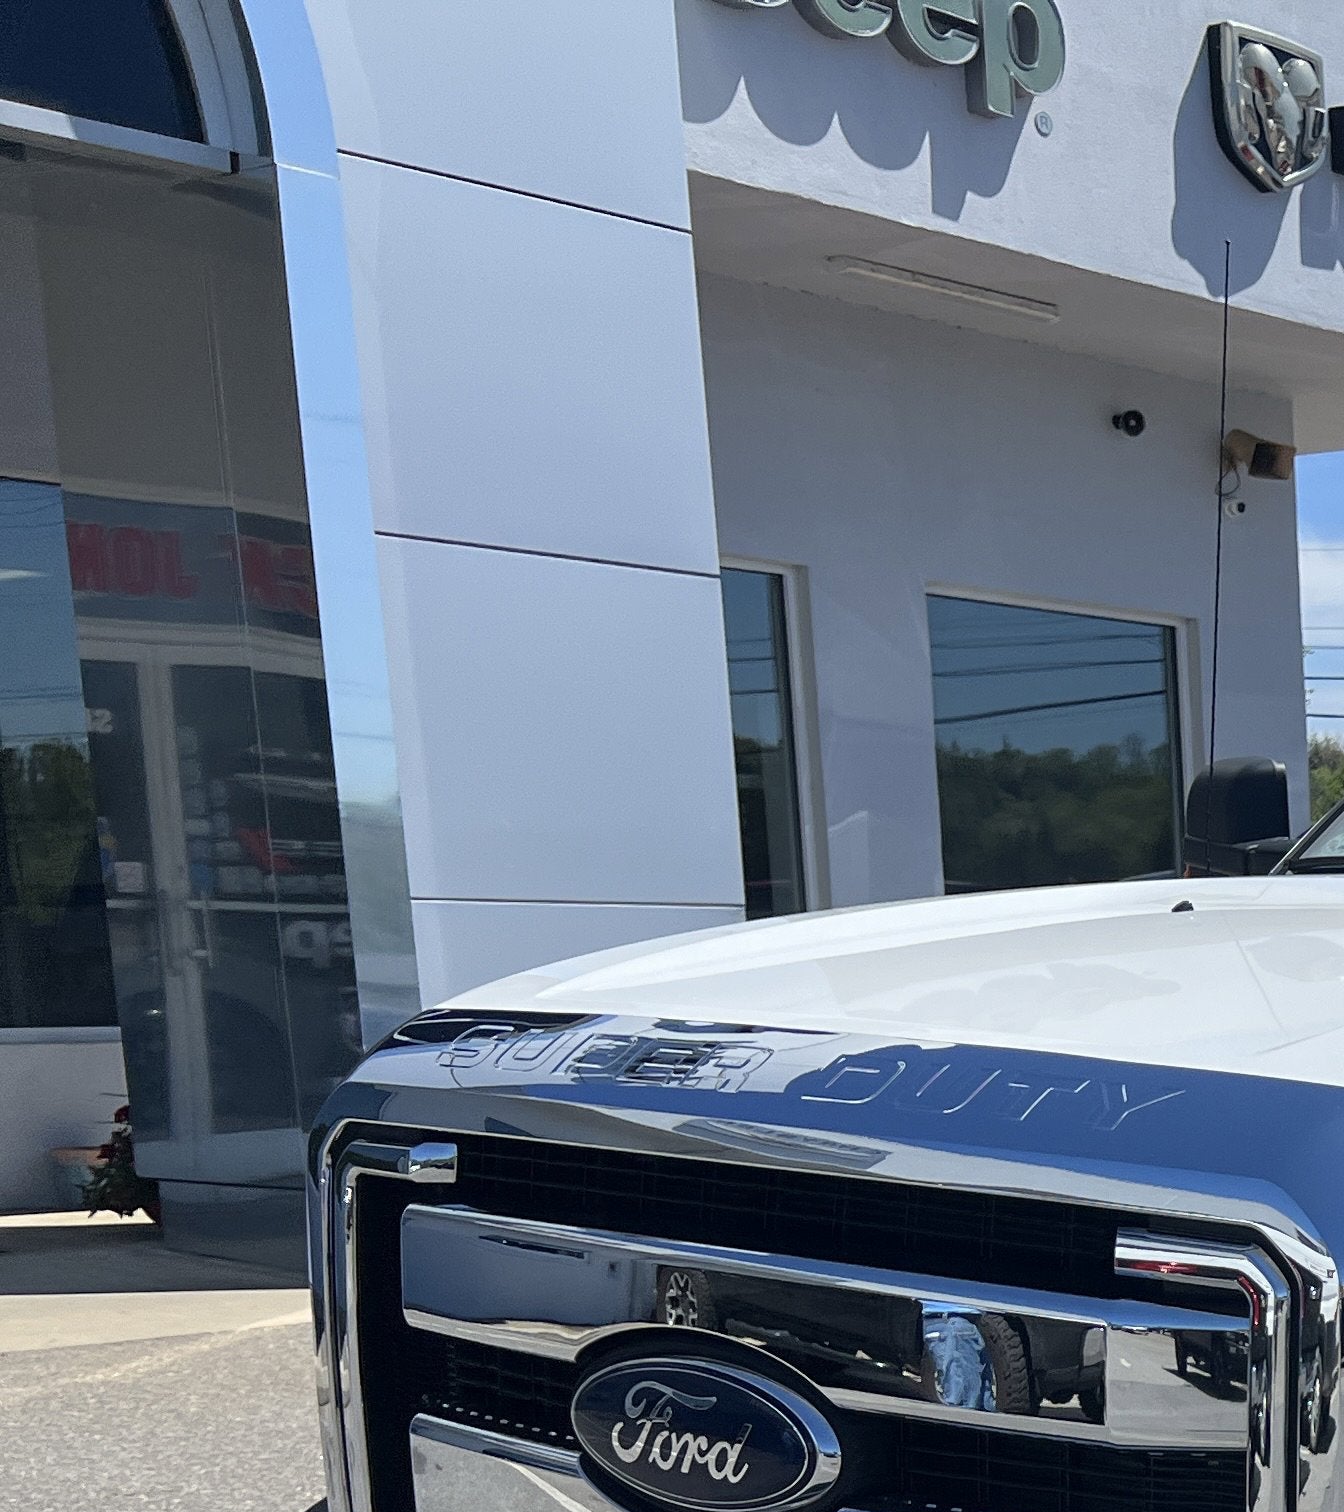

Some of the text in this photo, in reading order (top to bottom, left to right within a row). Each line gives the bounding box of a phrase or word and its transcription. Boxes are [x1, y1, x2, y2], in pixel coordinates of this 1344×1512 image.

[736, 0, 1066, 118] ep
[435, 1024, 1188, 1131] SUPER DUTY
[611, 1380, 753, 1484] Ford
